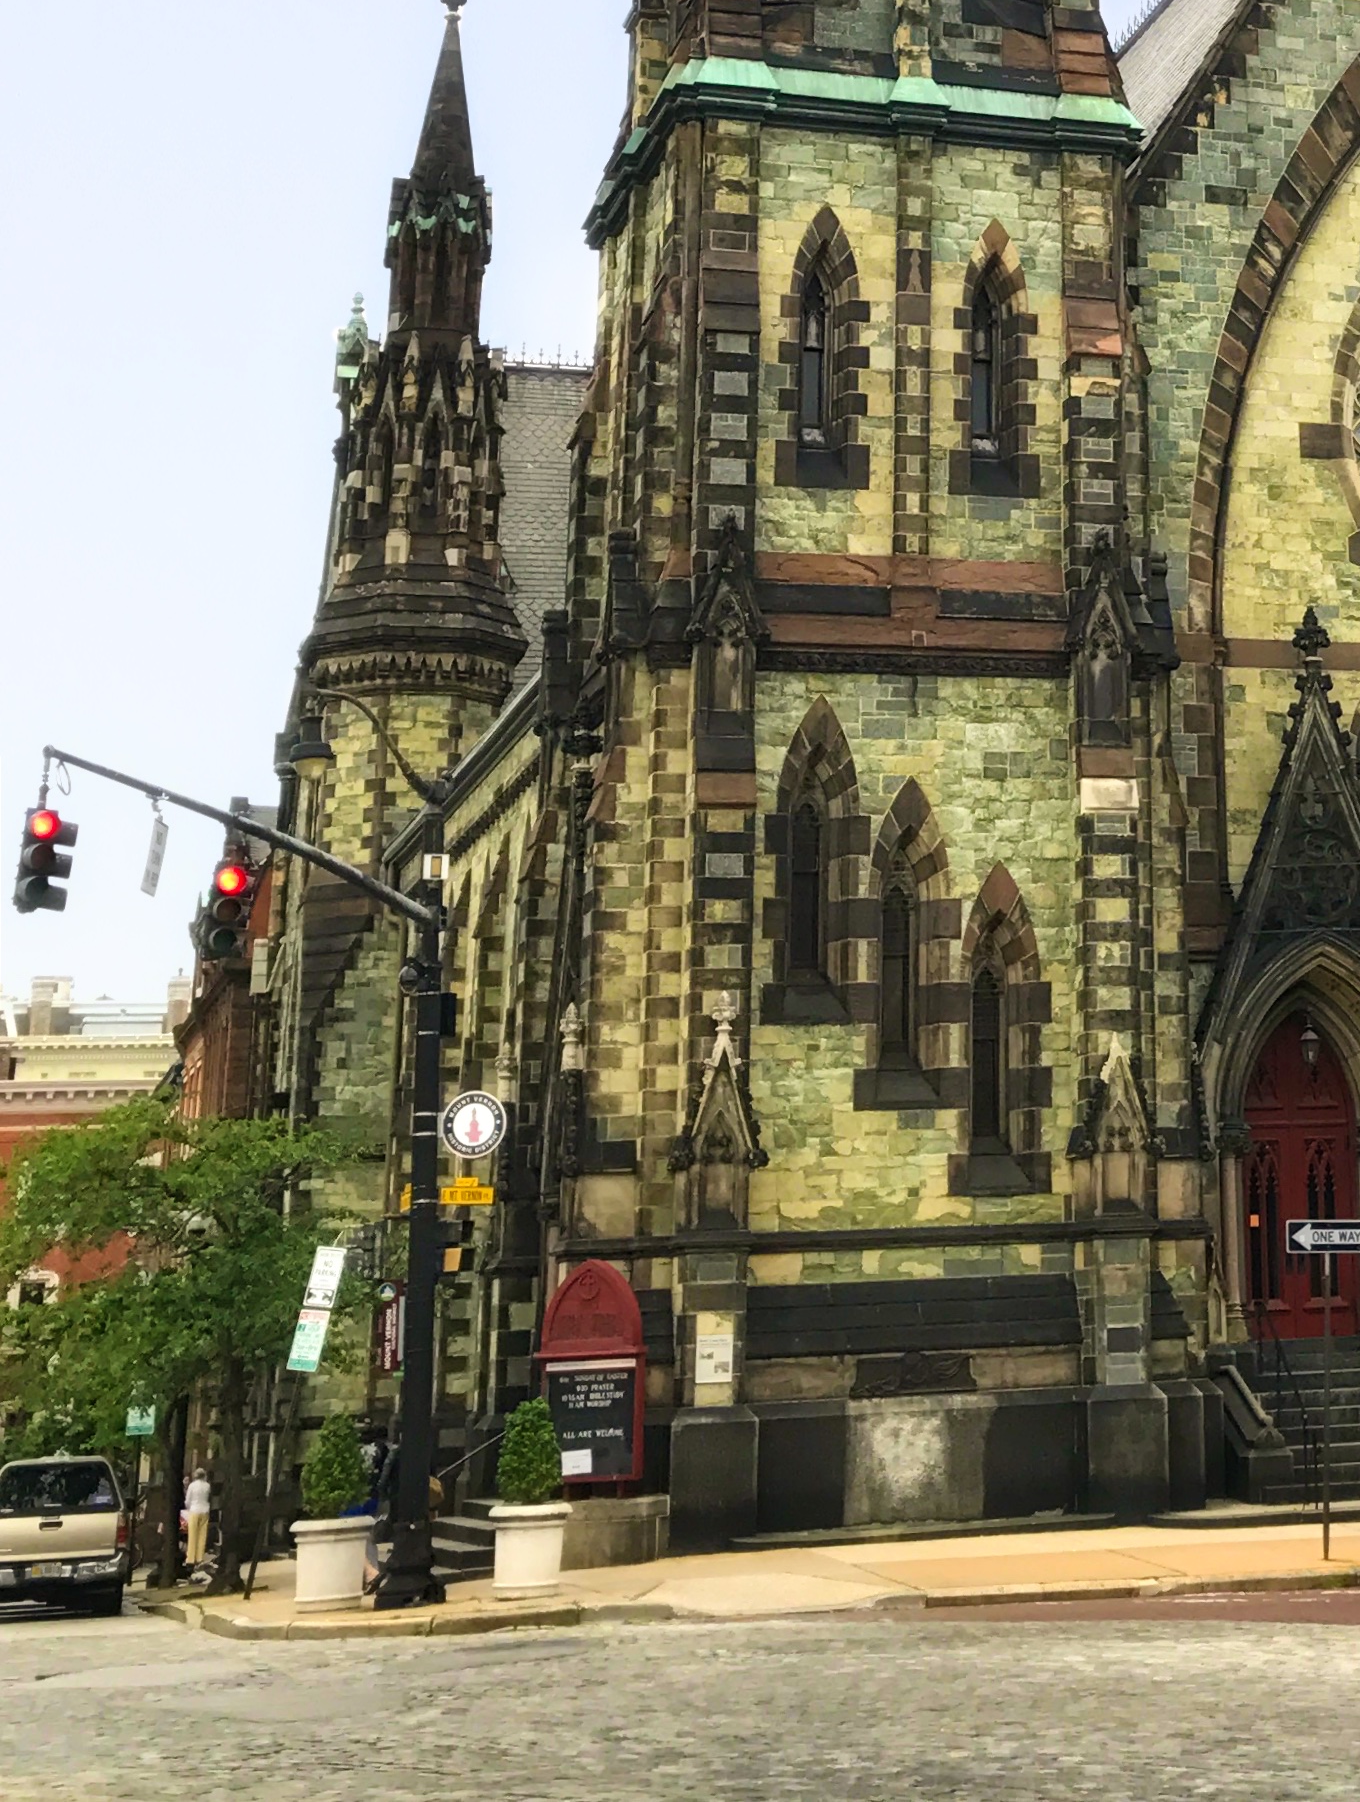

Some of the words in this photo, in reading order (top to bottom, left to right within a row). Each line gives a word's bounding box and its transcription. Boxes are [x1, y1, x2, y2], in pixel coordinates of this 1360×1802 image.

[1312, 1231, 1335, 1243] ONE
[591, 1383, 615, 1391] PRAYER
[563, 1430, 577, 1439] ALL
[578, 1430, 593, 1438] ARE
